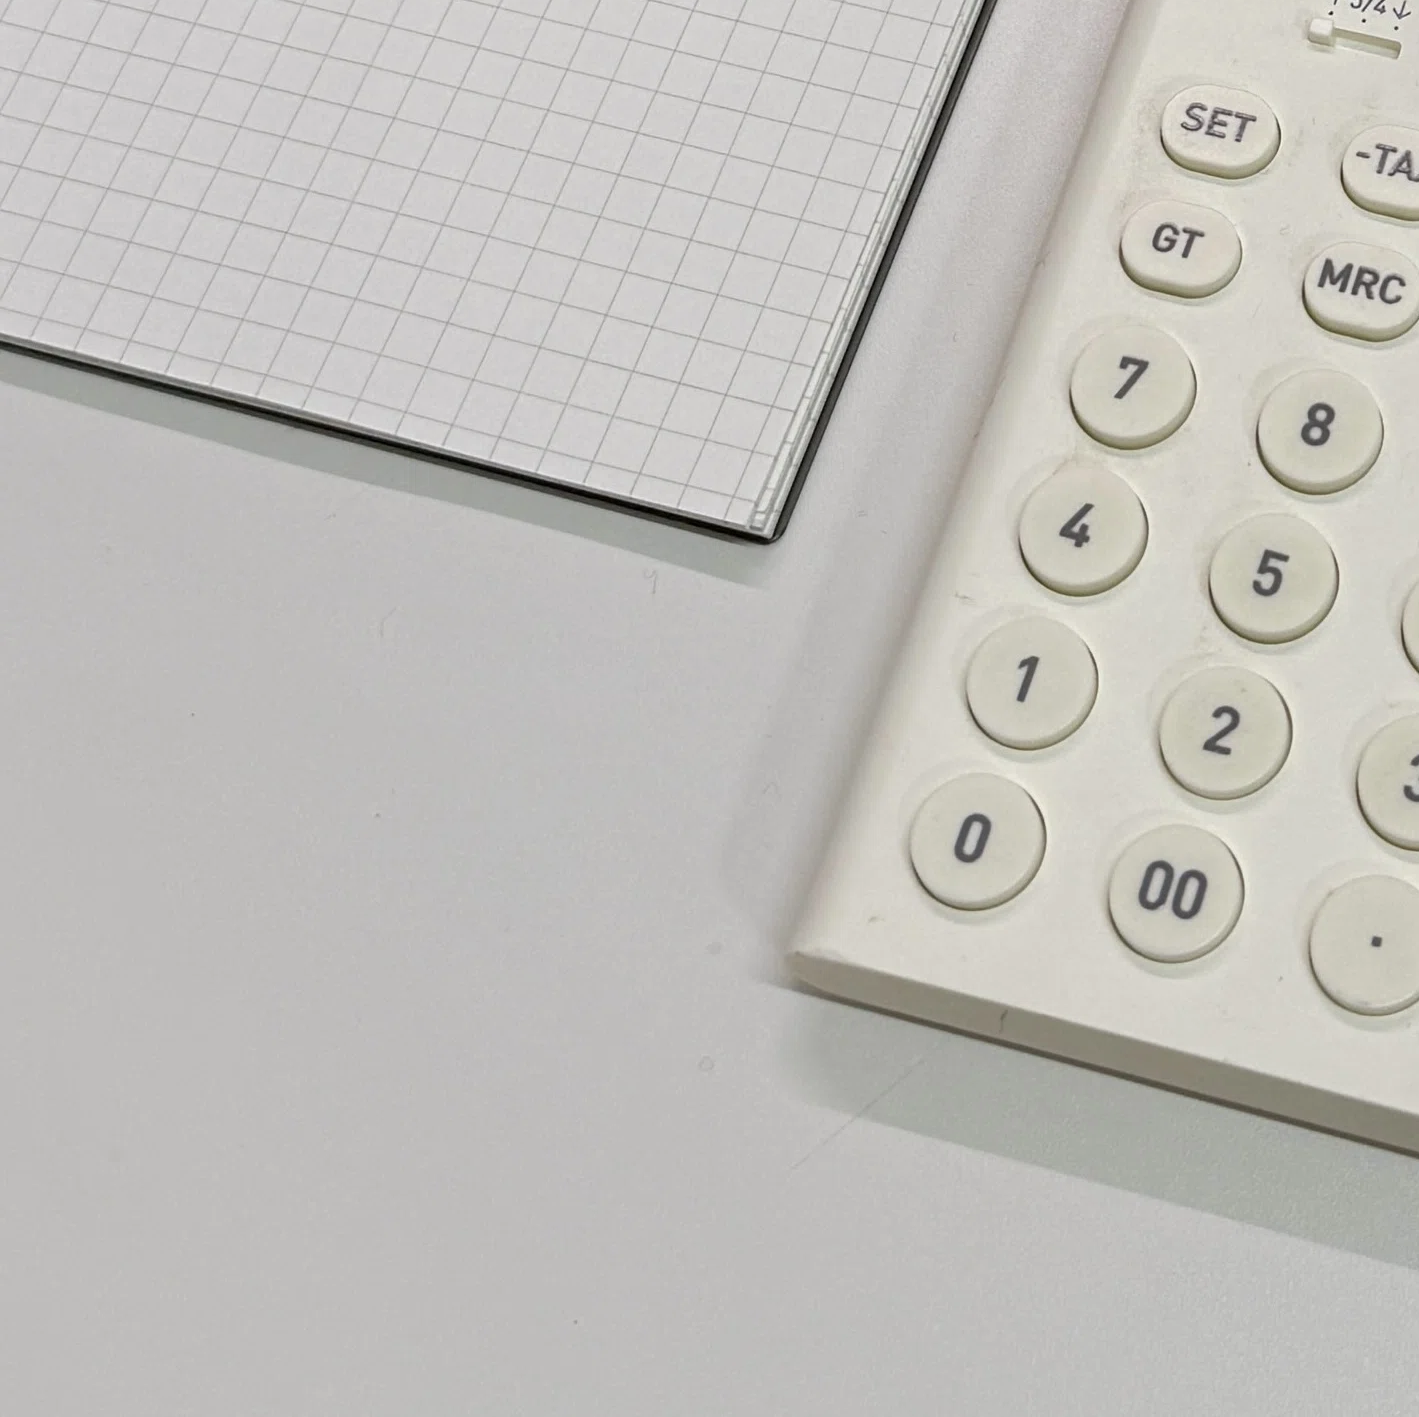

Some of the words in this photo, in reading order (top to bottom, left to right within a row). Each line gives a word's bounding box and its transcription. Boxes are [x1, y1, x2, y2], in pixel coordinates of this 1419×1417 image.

[1180, 102, 1258, 143] SET
[1151, 222, 1206, 259] GT
[1317, 258, 1407, 305] MRC
[1113, 355, 1150, 400] 7
[1300, 402, 1336, 447] 8
[1058, 502, 1095, 549] 4
[1252, 548, 1290, 598] 5
[1016, 655, 1040, 703] 1
[1202, 705, 1241, 756] 2
[953, 813, 992, 864] 0
[1137, 859, 1208, 920] 00
